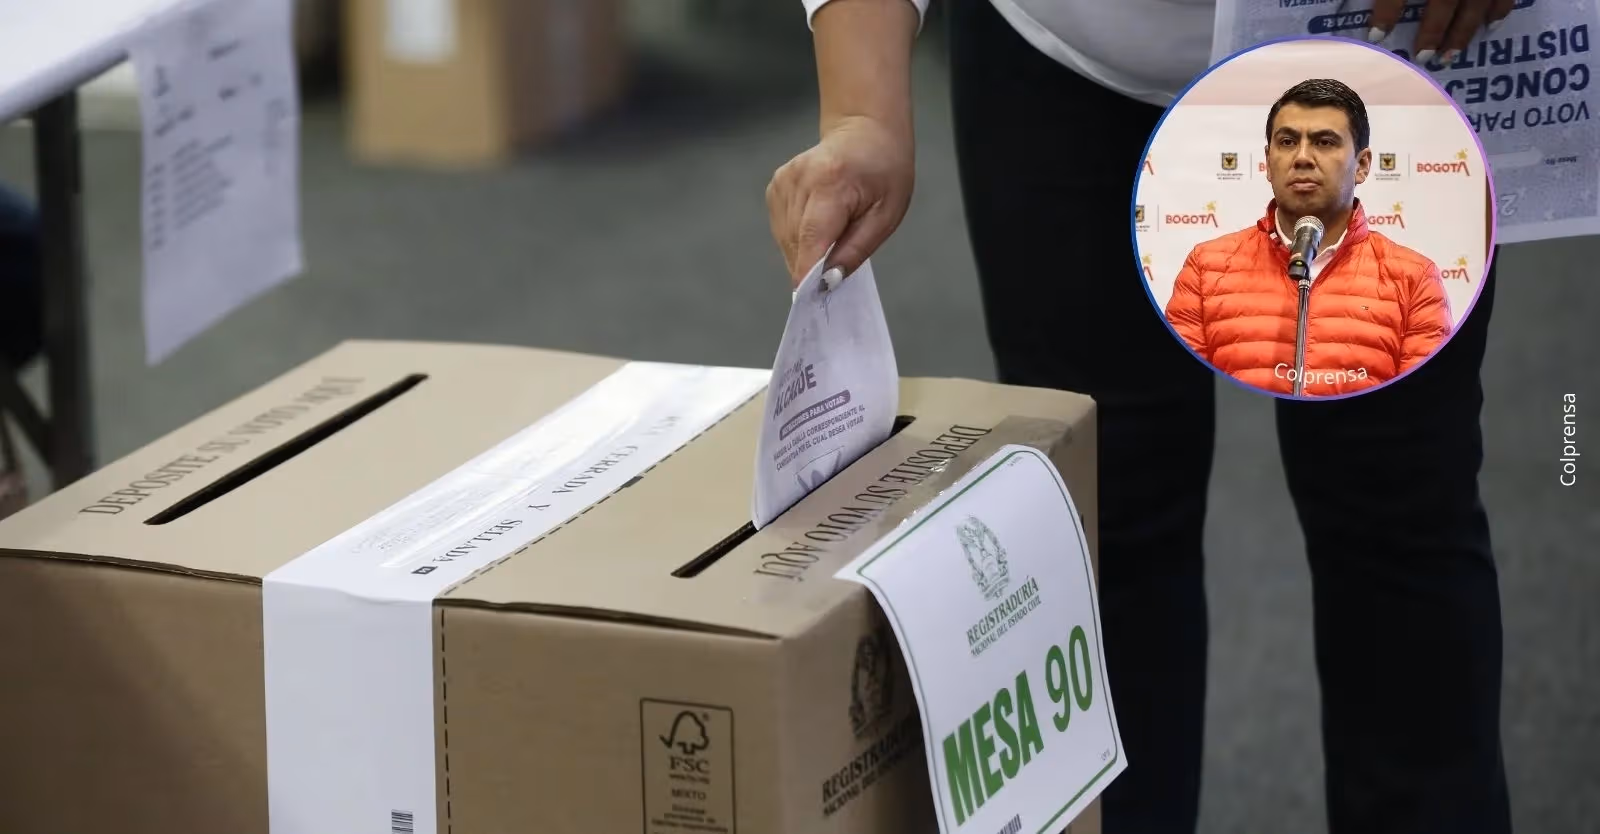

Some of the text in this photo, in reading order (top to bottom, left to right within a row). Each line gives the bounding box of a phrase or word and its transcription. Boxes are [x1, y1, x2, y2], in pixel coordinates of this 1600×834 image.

[1524, 101, 1590, 128] VOTO
[551, 445, 639, 495] CERRADA
[878, 424, 993, 487] DEPOSITE
[79, 453, 220, 515] DEPOSITE
[854, 484, 907, 506] SU
[432, 518, 523, 564] SELLADA
[803, 505, 882, 542] VOTO
[966, 574, 1039, 647] REGISTRADURÍA
[942, 624, 1094, 828] MESA 90
[669, 756, 711, 775] FSC
